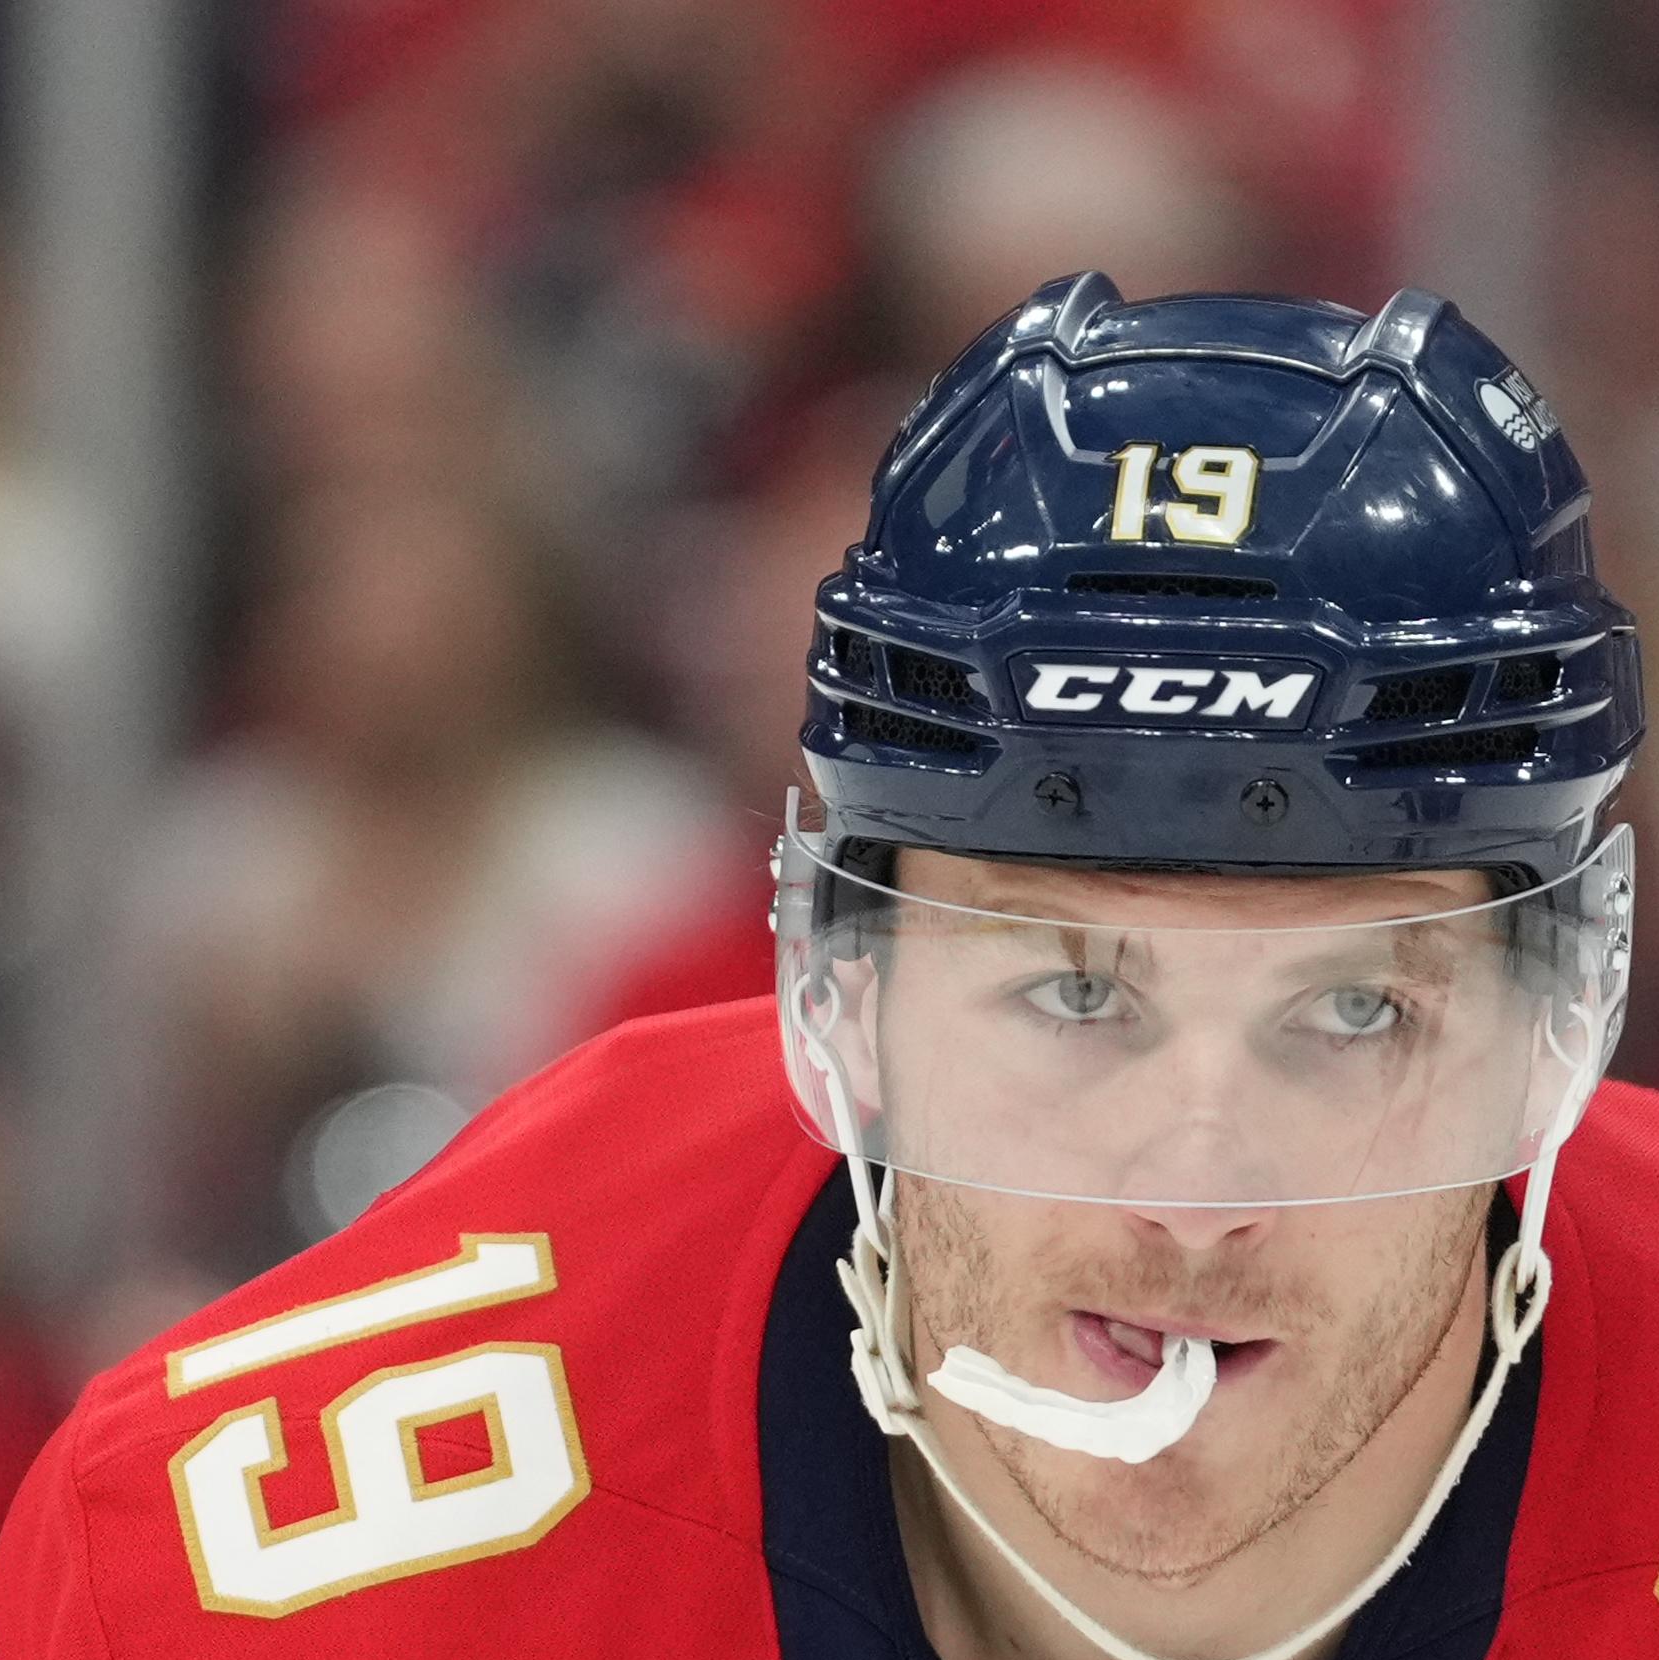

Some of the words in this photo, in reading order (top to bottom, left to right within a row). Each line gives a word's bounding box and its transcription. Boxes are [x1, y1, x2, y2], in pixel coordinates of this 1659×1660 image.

[1108, 441, 1260, 546] 19
[1024, 662, 1316, 720] CCM
[165, 1232, 591, 1619] 19
